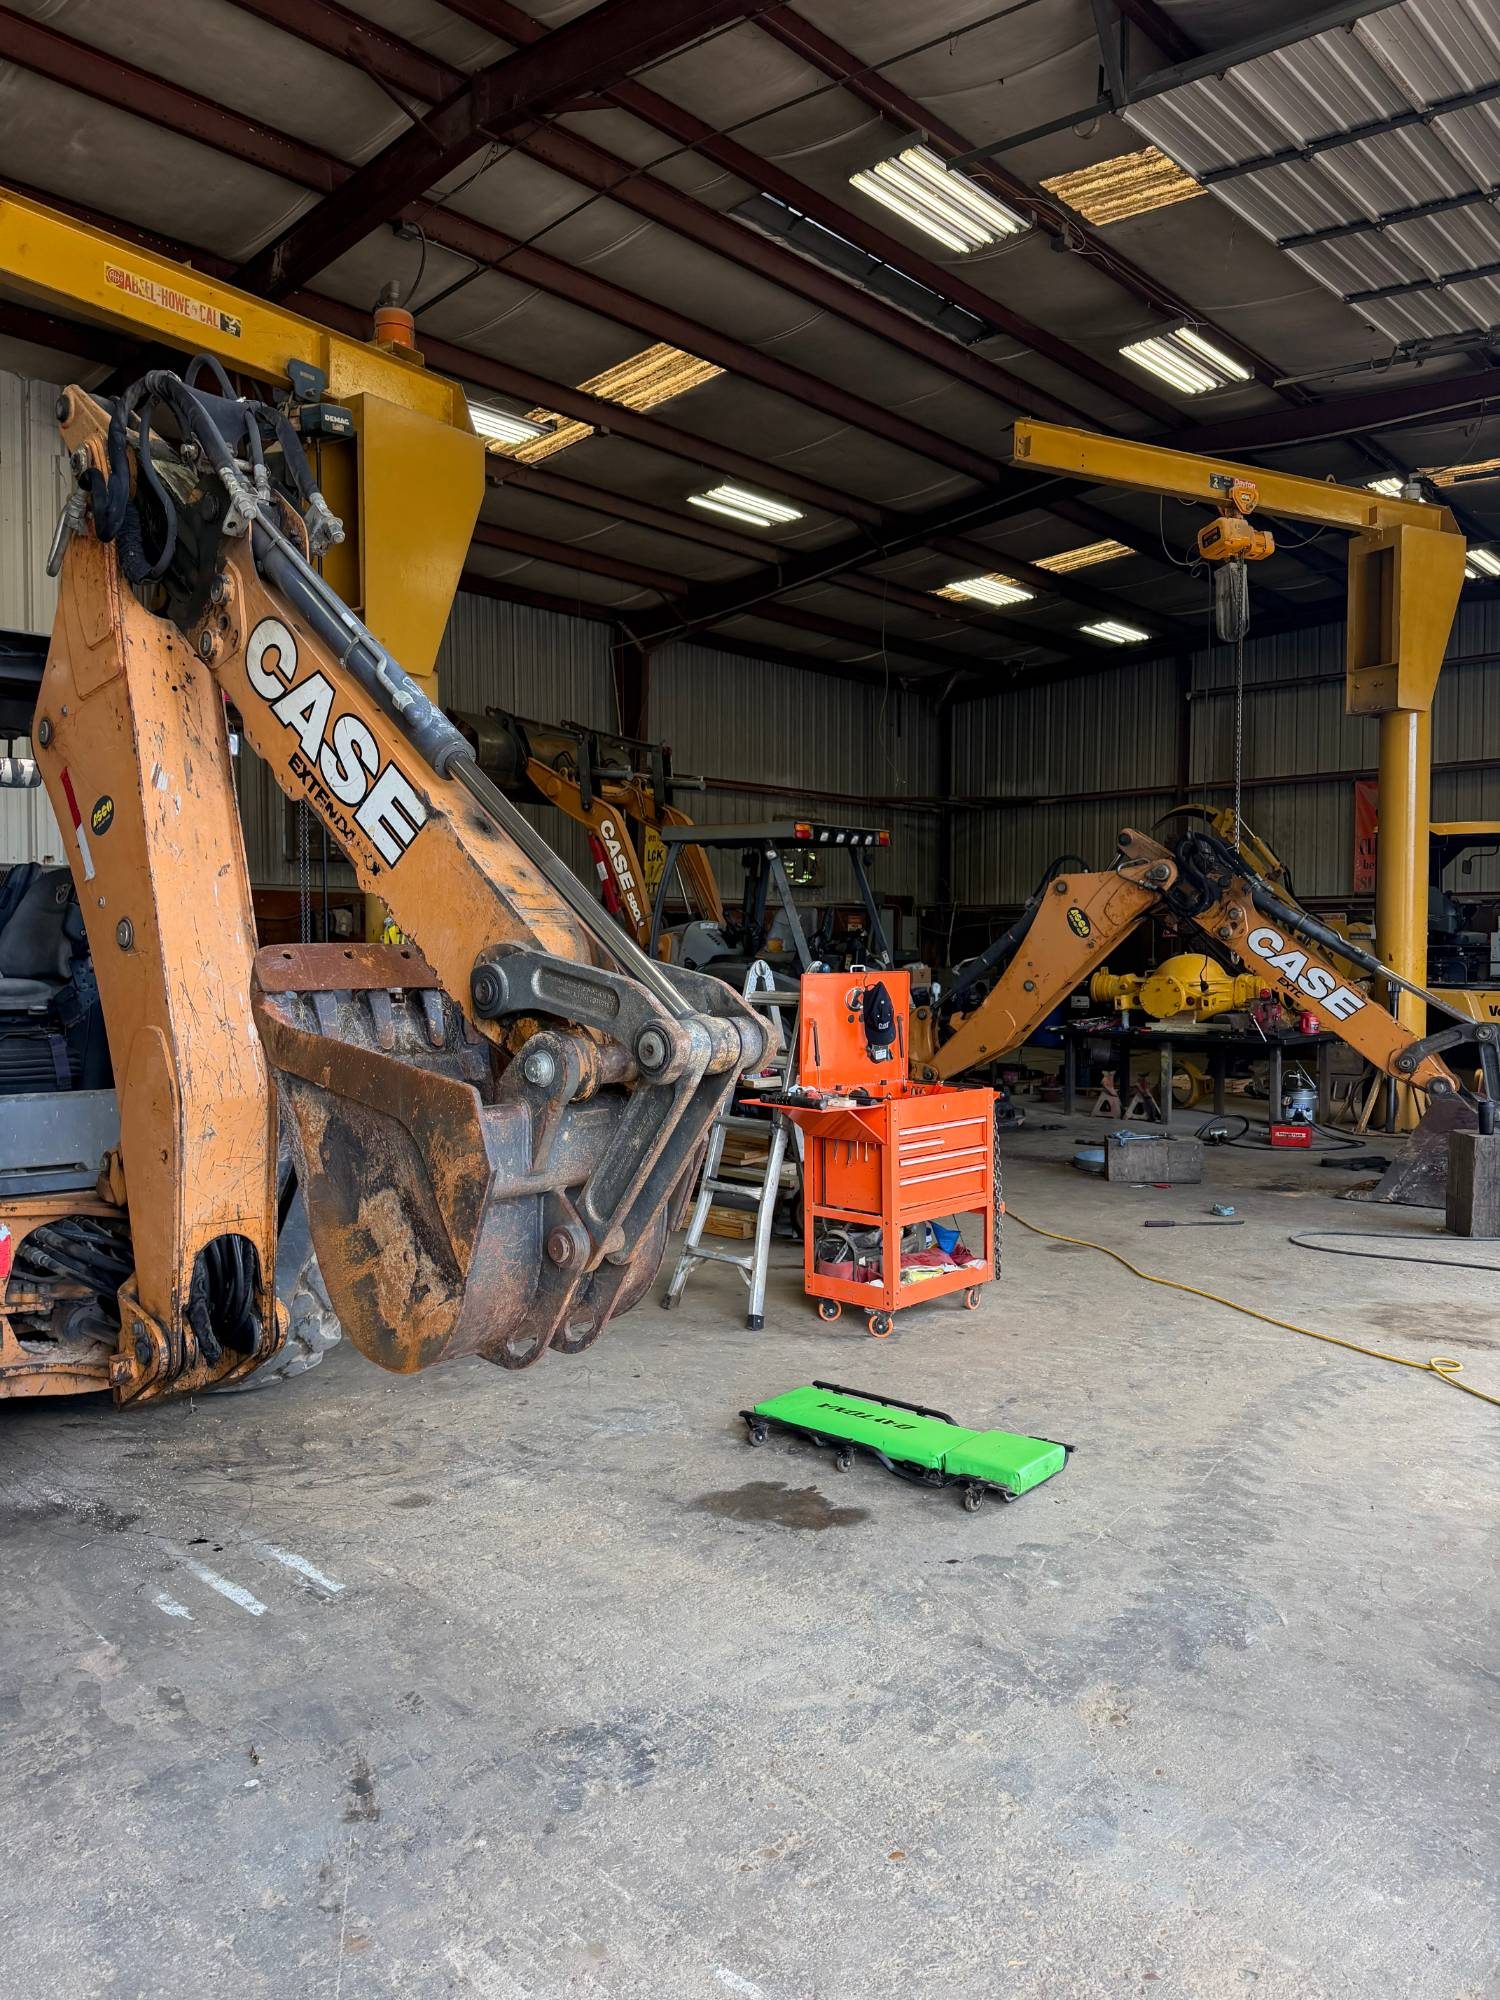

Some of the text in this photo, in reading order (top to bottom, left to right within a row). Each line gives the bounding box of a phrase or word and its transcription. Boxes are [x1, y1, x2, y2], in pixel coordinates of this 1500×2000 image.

[245, 616, 428, 869] CASE
[601, 819, 635, 891] CASE
[1246, 926, 1368, 1022] CASE
